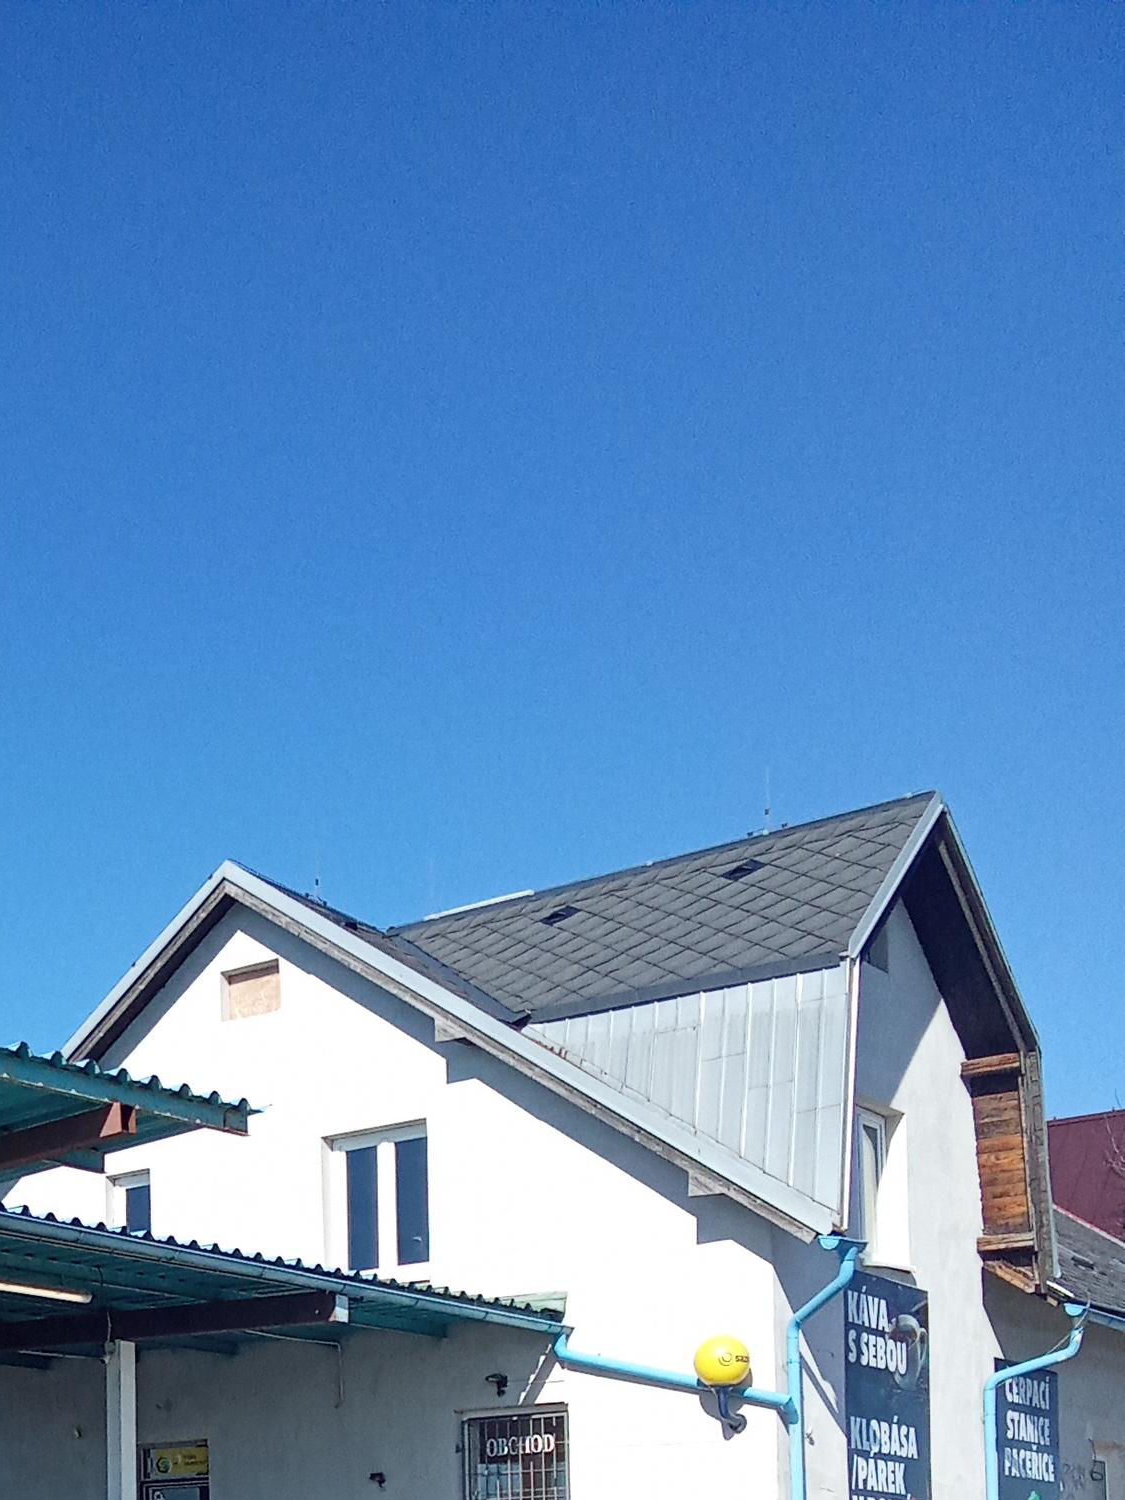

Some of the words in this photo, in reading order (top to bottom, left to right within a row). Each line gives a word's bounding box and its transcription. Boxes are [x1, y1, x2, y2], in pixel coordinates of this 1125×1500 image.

[847, 1285, 890, 1333] KÁVA
[848, 1329, 857, 1364] S
[859, 1331, 908, 1376] SEBOU
[486, 1433, 556, 1458] OBCHOD
[850, 1414, 919, 1459] KLOBÁSA
[1005, 1409, 1051, 1446] STANICE
[1004, 1443, 1055, 1483] PACEŘICE
